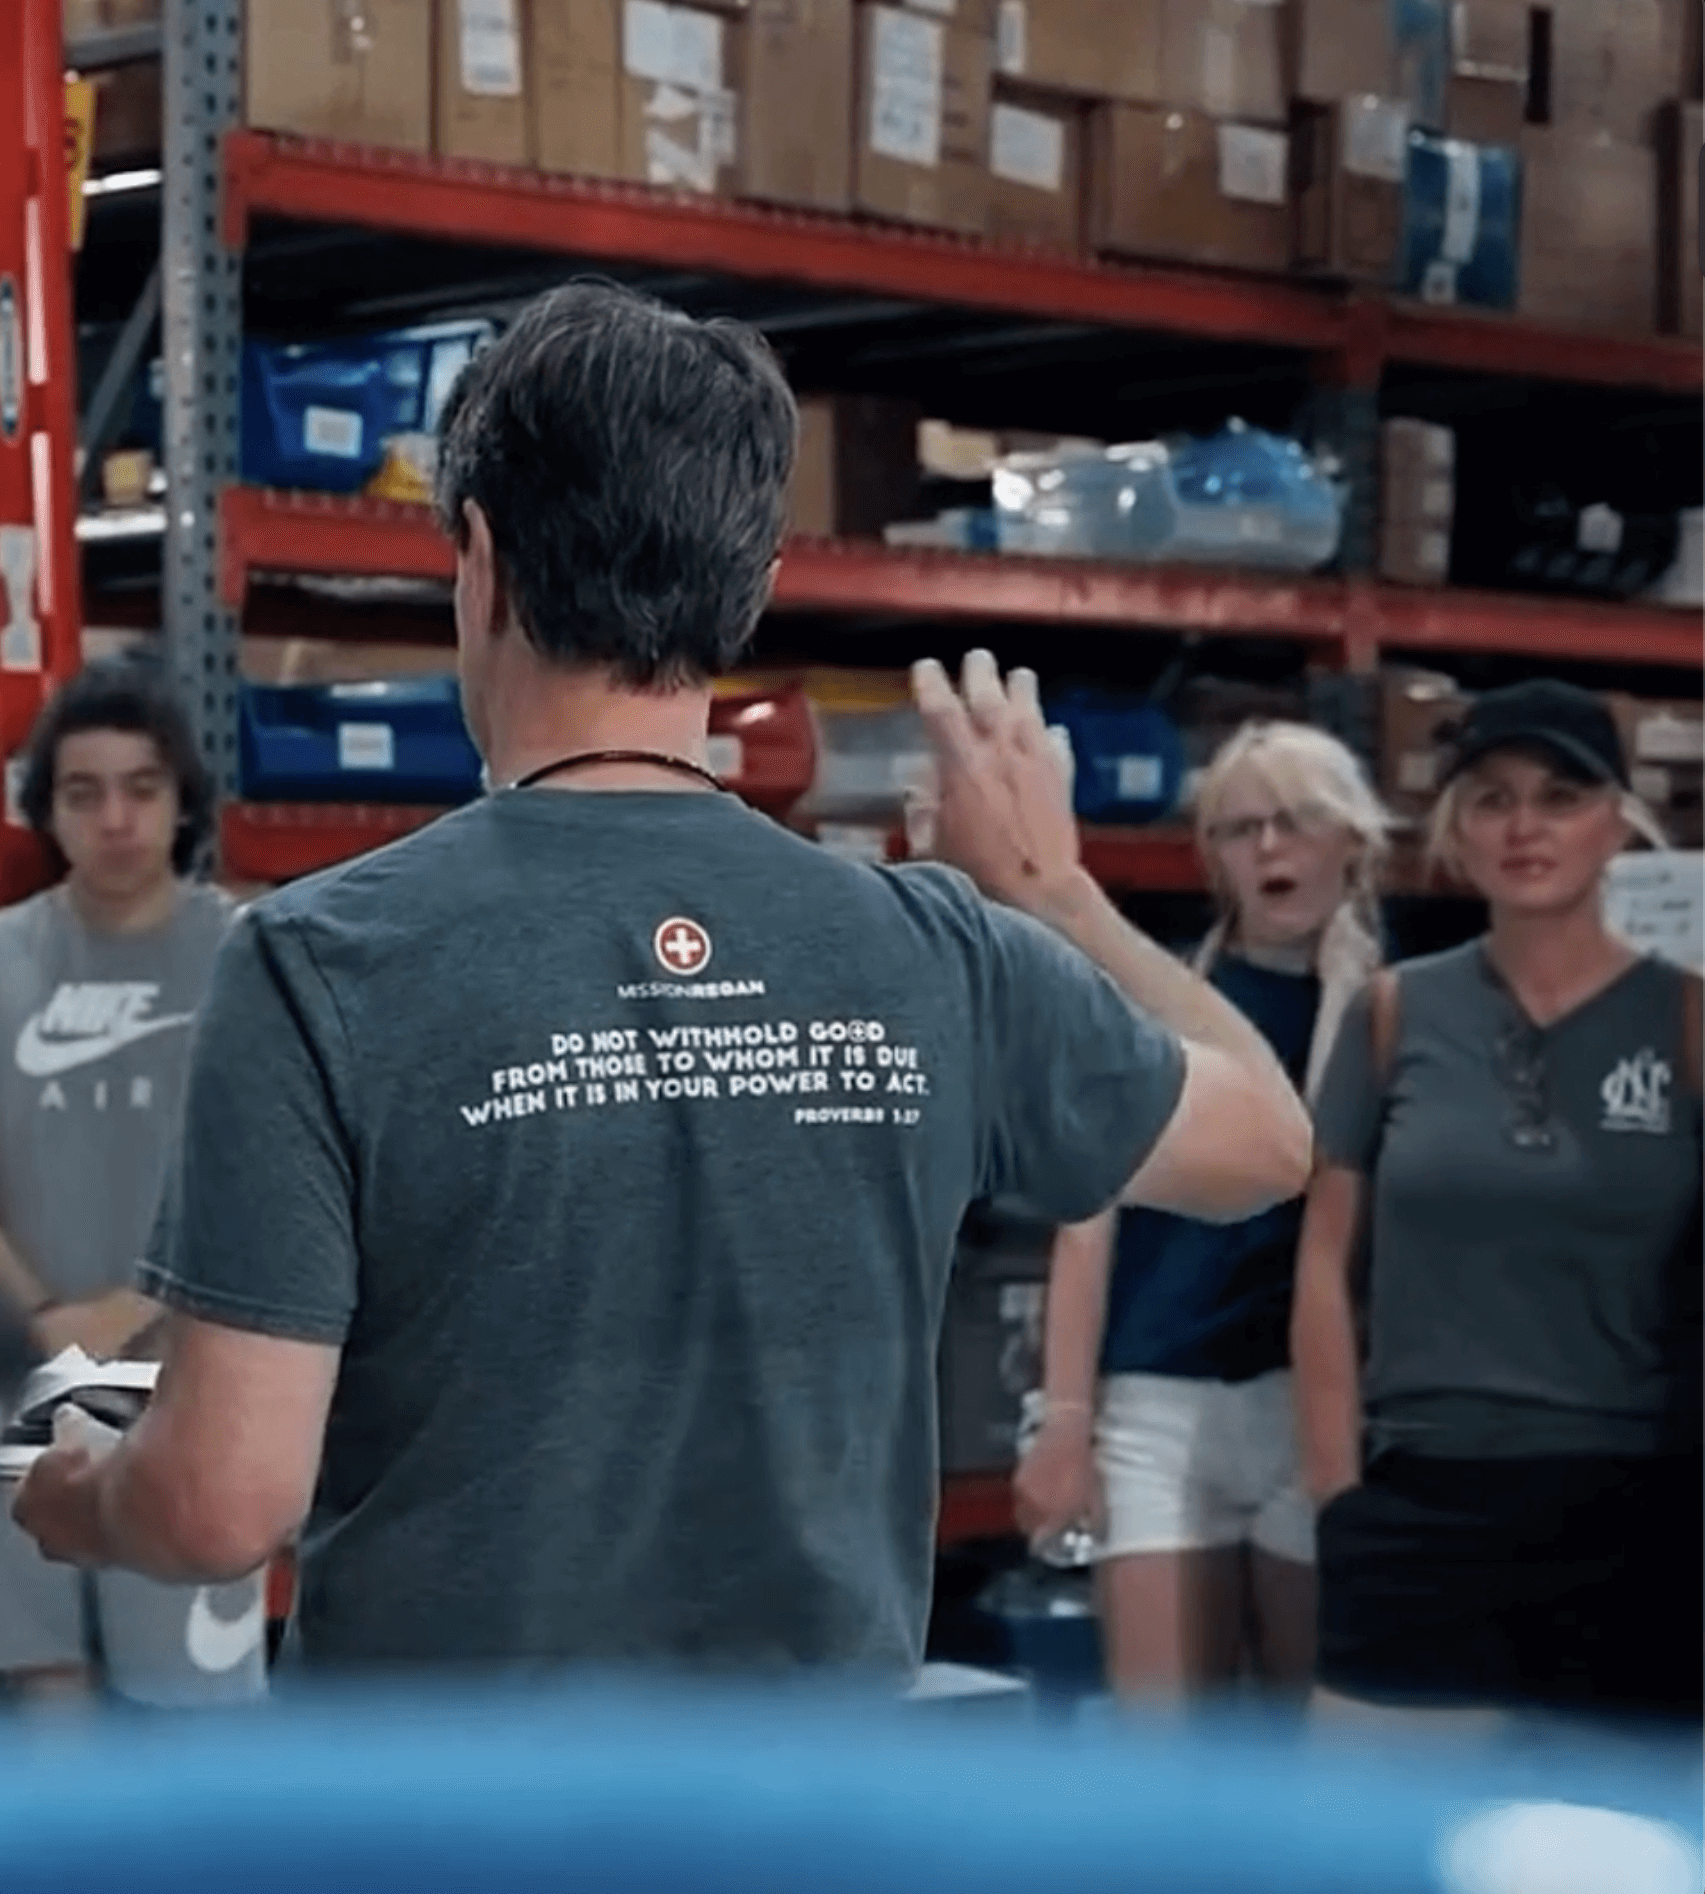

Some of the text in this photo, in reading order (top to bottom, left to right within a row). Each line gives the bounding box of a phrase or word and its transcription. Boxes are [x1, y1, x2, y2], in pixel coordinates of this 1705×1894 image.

[42, 981, 160, 1035] NIKE
[550, 1033, 586, 1057] DO
[591, 1028, 640, 1053] NOT
[647, 1021, 798, 1049] WITHHOLD
[491, 1045, 918, 1094] FROM THOSE TO WHOM IT IS DUE
[40, 1075, 153, 1111] AIR
[460, 1090, 547, 1127] WHEN
[554, 1085, 579, 1109] IT
[585, 1082, 607, 1105] IS
[613, 1079, 640, 1102] IN
[645, 1077, 719, 1100] YOUR
[728, 1070, 829, 1097] POWER
[839, 1070, 876, 1092] TO
[795, 1106, 885, 1125] PROVERBS
